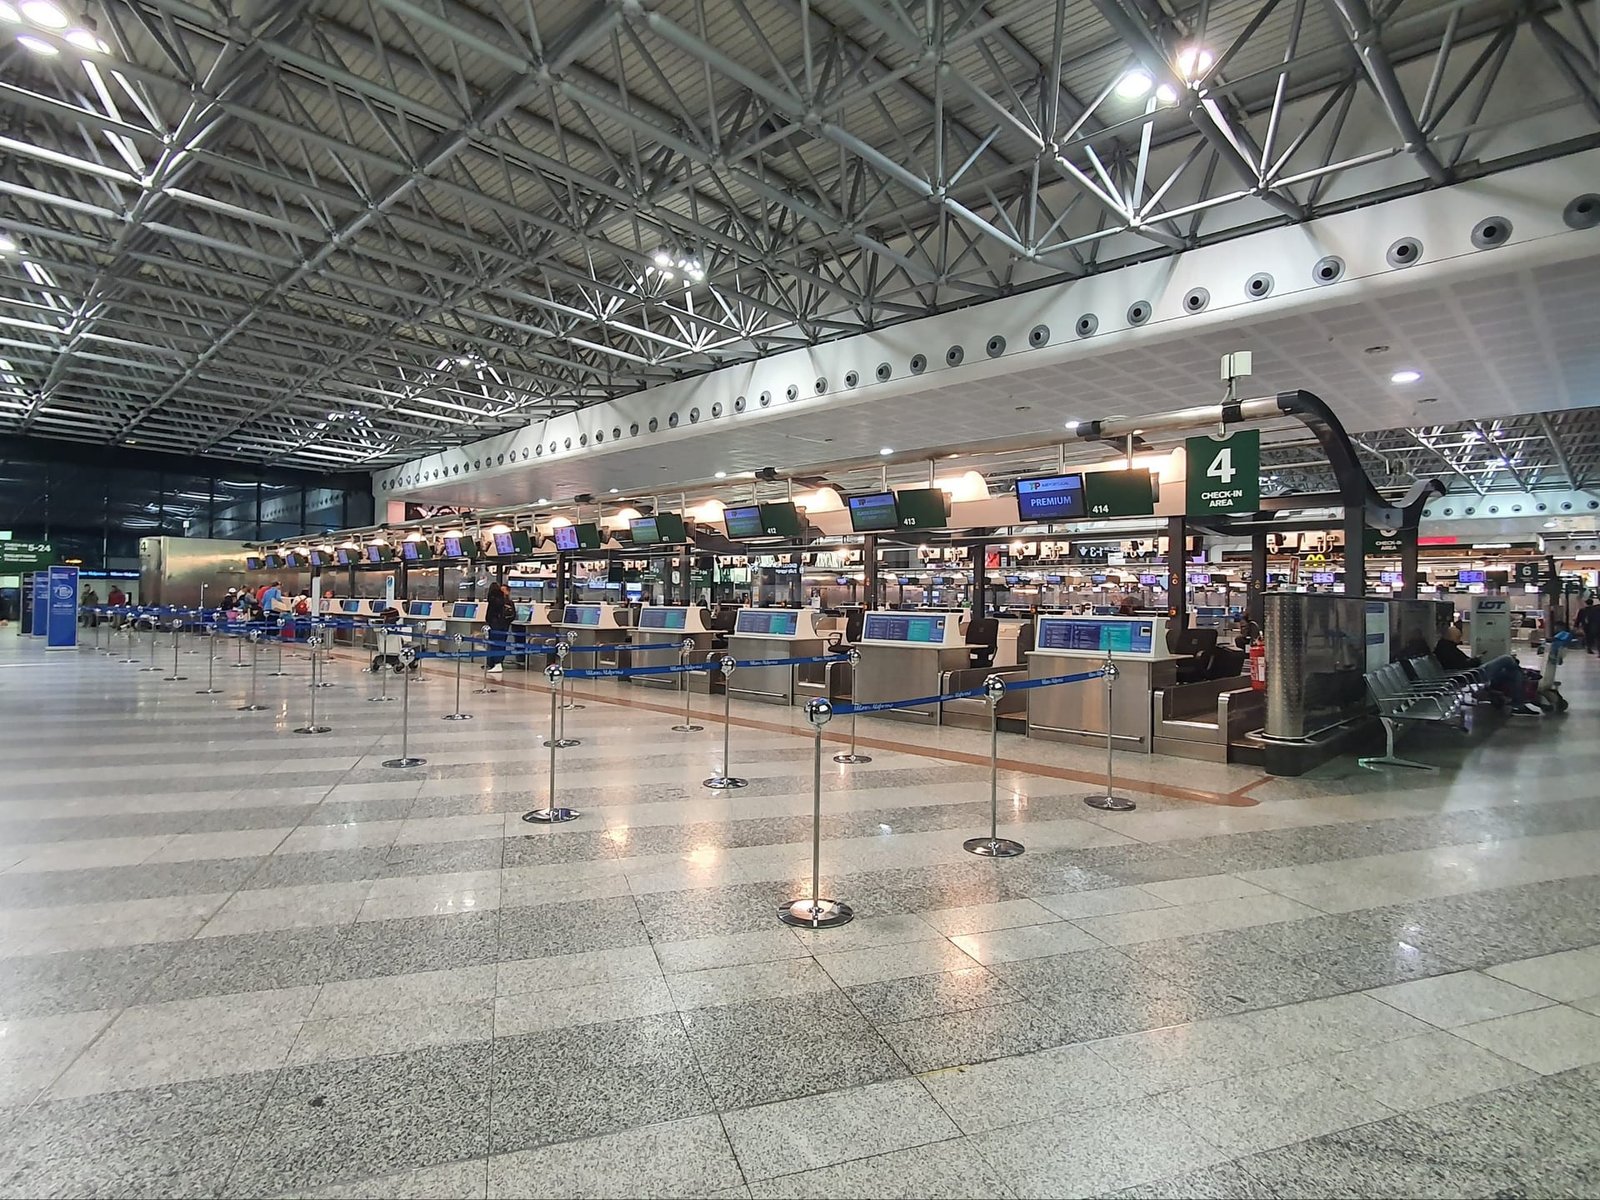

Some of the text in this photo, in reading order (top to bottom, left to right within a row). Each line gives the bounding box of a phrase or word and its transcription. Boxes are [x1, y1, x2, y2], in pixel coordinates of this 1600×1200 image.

[1206, 447, 1236, 484] 4
[1201, 489, 1243, 500] CHECK-IN
[1030, 495, 1072, 507] PREMIUM
[1209, 498, 1234, 507] AREA
[1092, 504, 1110, 514] 414
[903, 517, 916, 526] 413
[27, 543, 52, 552] 5-24
[141, 541, 147, 552] 4
[1522, 566, 1532, 576] 6
[1478, 601, 1506, 610] LOT
